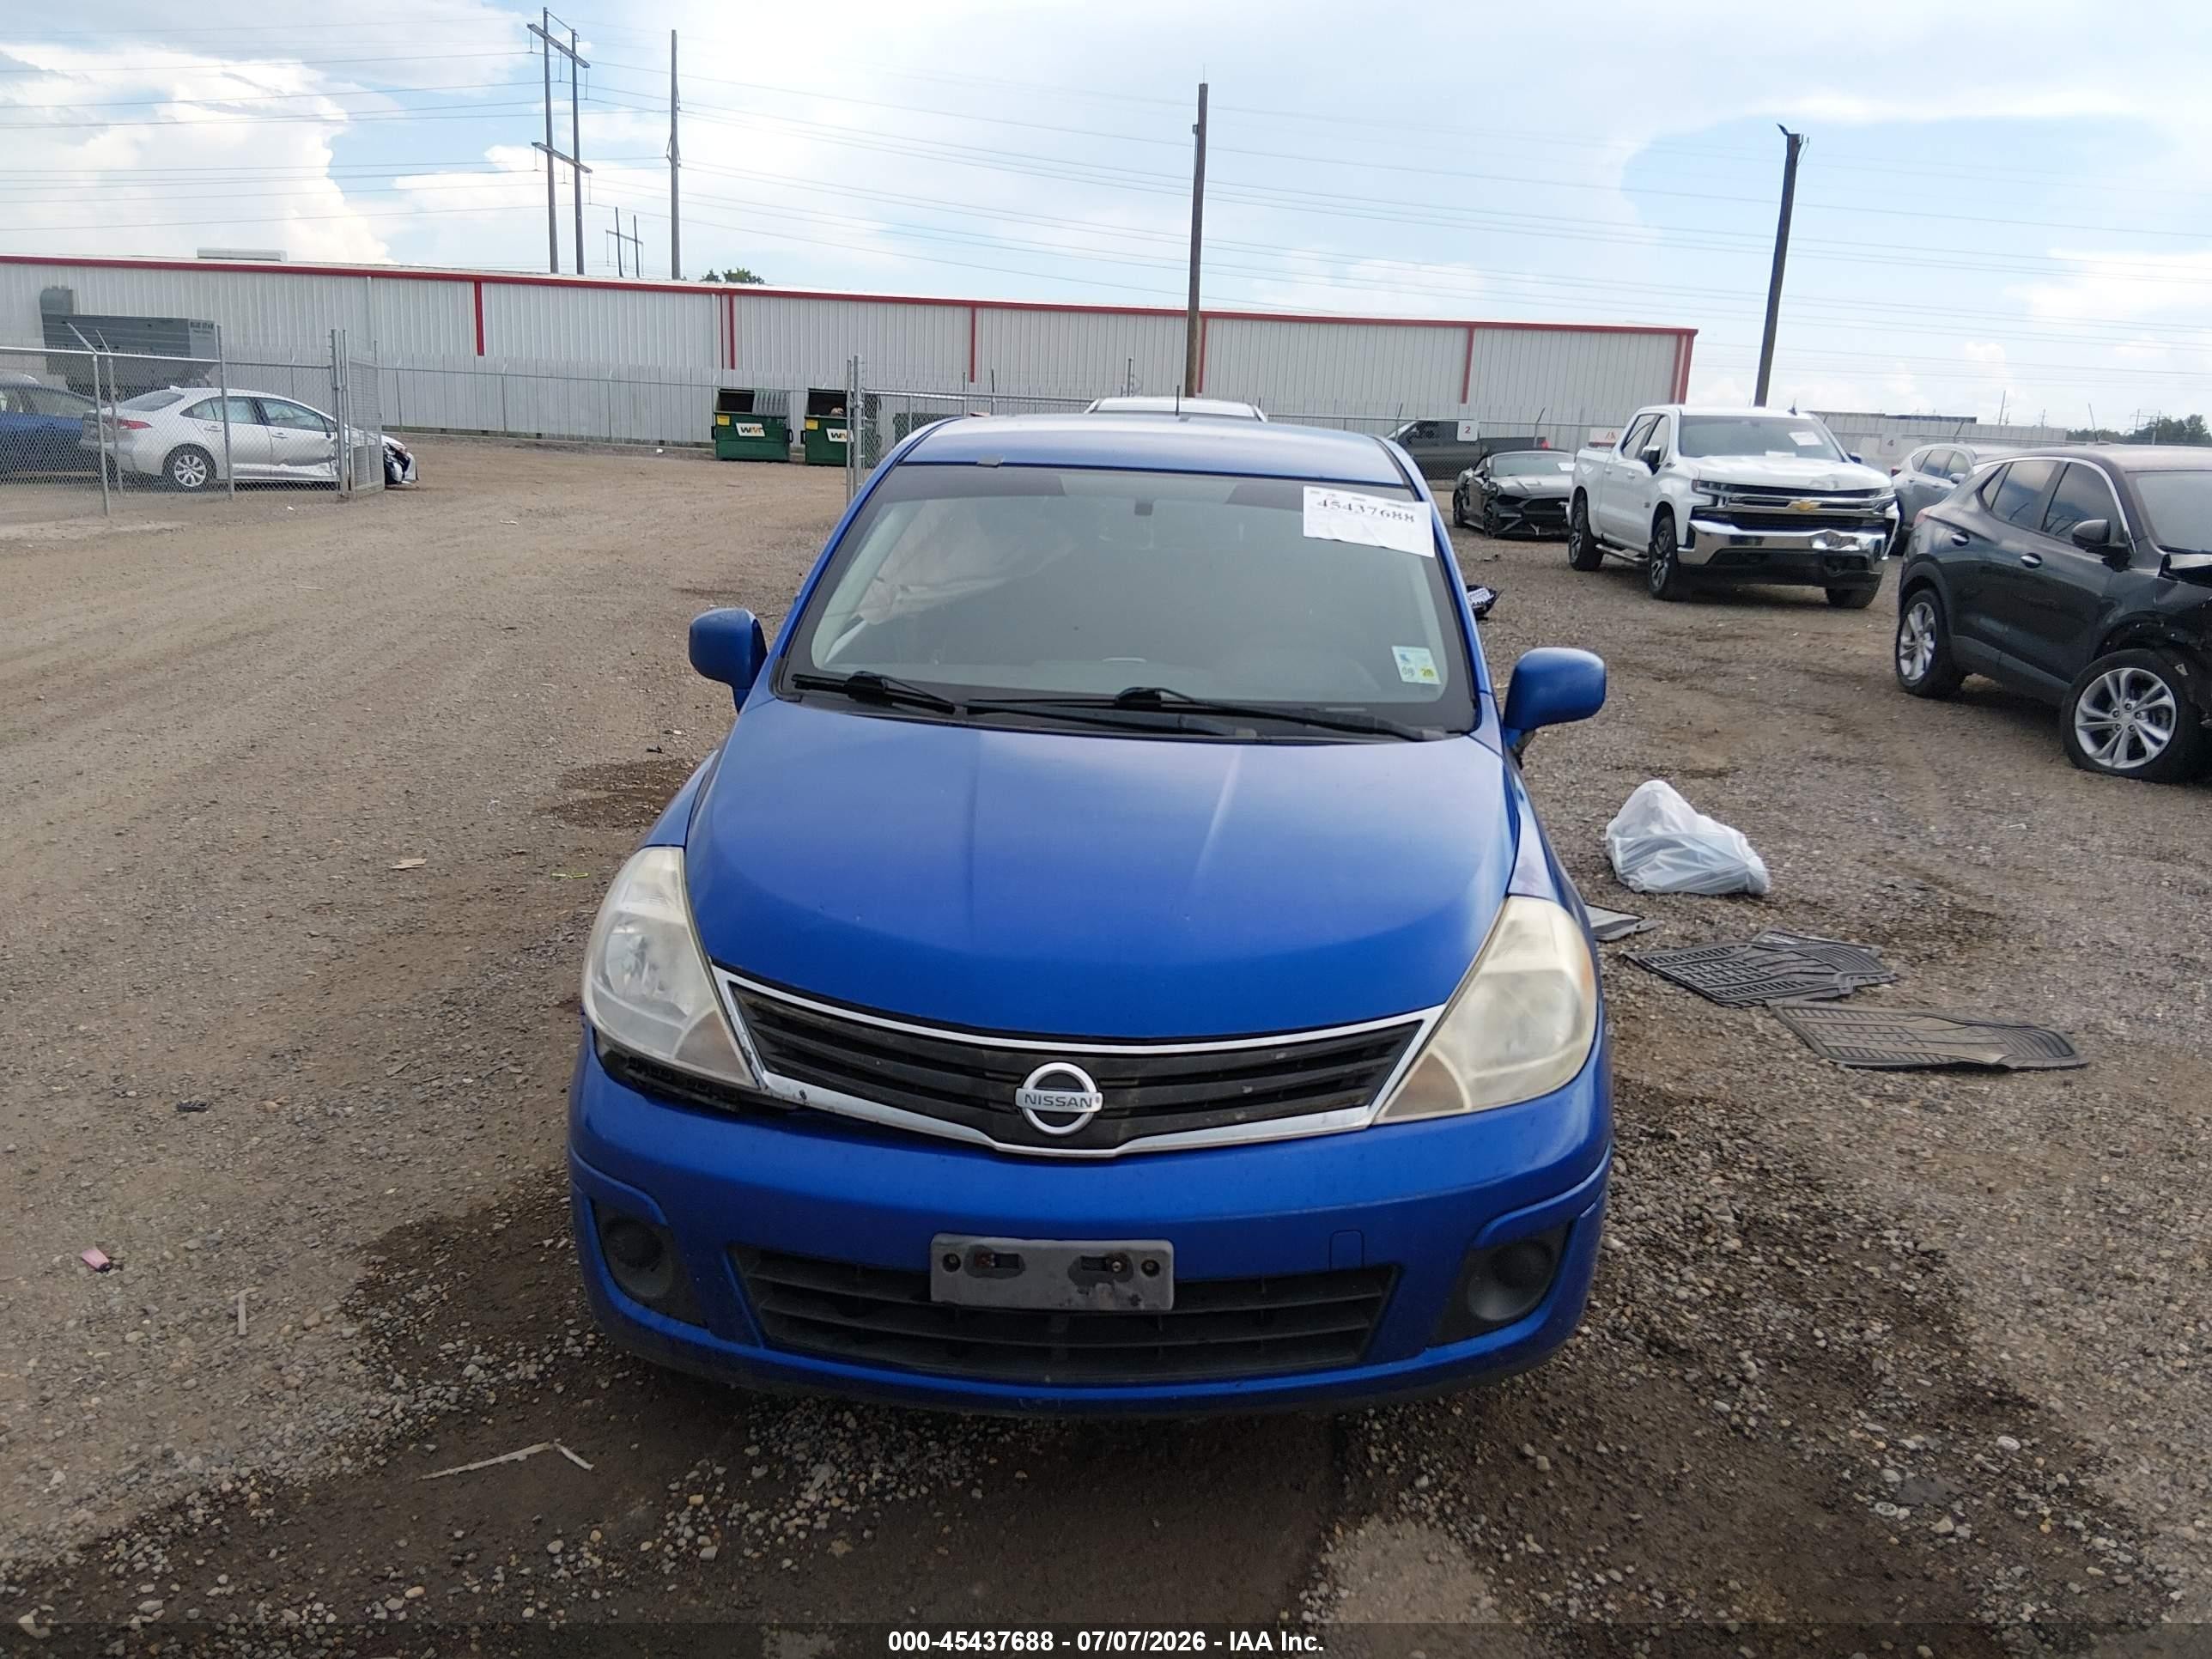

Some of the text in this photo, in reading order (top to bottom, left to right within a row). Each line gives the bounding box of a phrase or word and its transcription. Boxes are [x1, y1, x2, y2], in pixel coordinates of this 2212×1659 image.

[1464, 425, 1471, 434] 2
[1316, 498, 1415, 523] 45437688
[1024, 1093, 1093, 1108] NISSAN
